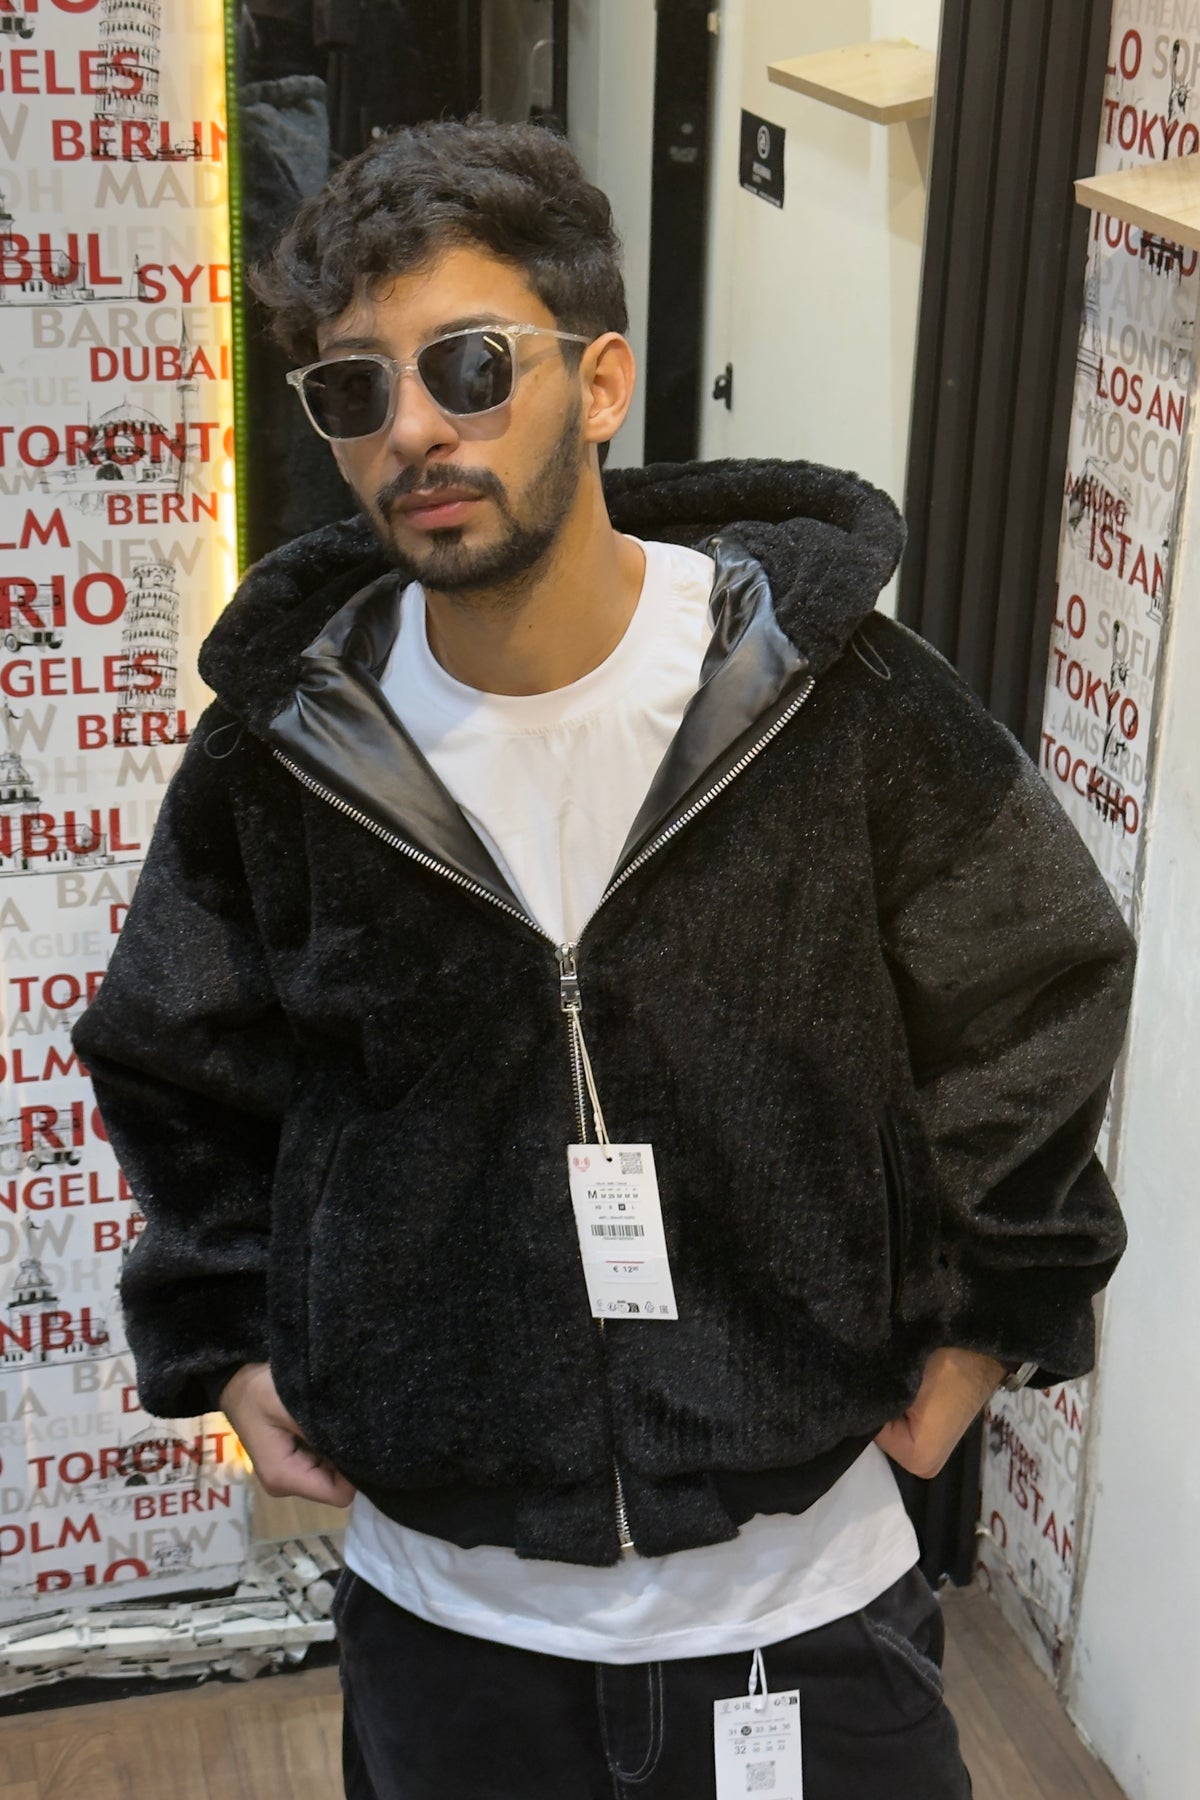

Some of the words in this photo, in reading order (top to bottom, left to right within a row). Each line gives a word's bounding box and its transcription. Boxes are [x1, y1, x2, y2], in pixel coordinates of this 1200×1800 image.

[0, 49, 144, 95] ELES
[89, 344, 229, 383] DUBAI
[1096, 357, 1143, 415] LOS
[1146, 384, 1185, 436] AN
[0, 421, 234, 467] TORONT
[1081, 403, 1178, 492] MOSCO
[107, 492, 218, 525] BERN
[77, 538, 204, 579] NEW
[0, 572, 127, 629] RIO
[1053, 647, 1139, 741] TOKYO
[0, 1046, 91, 1084] LM
[587, 1190, 597, 1199] M
[28, 1431, 247, 1489] TORONT
[134, 1486, 231, 1521] BERN
[734, 1745, 747, 1755] 32
